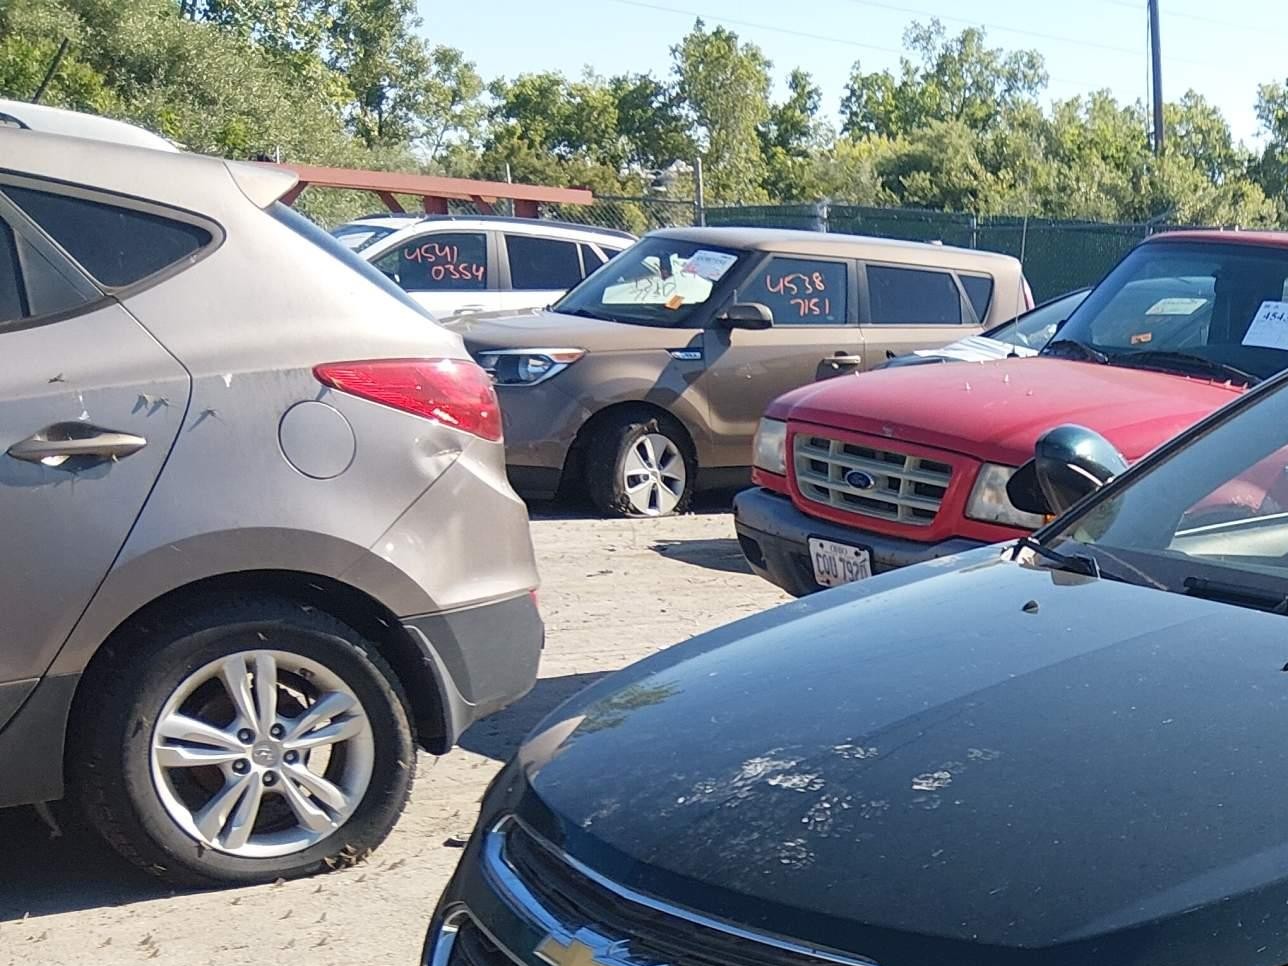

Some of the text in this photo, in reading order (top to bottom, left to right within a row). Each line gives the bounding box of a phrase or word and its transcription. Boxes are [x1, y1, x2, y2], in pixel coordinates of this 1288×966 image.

[404, 243, 458, 263] 4541
[431, 264, 484, 281] 0354
[766, 272, 825, 295] 4538
[790, 298, 829, 316] 7151
